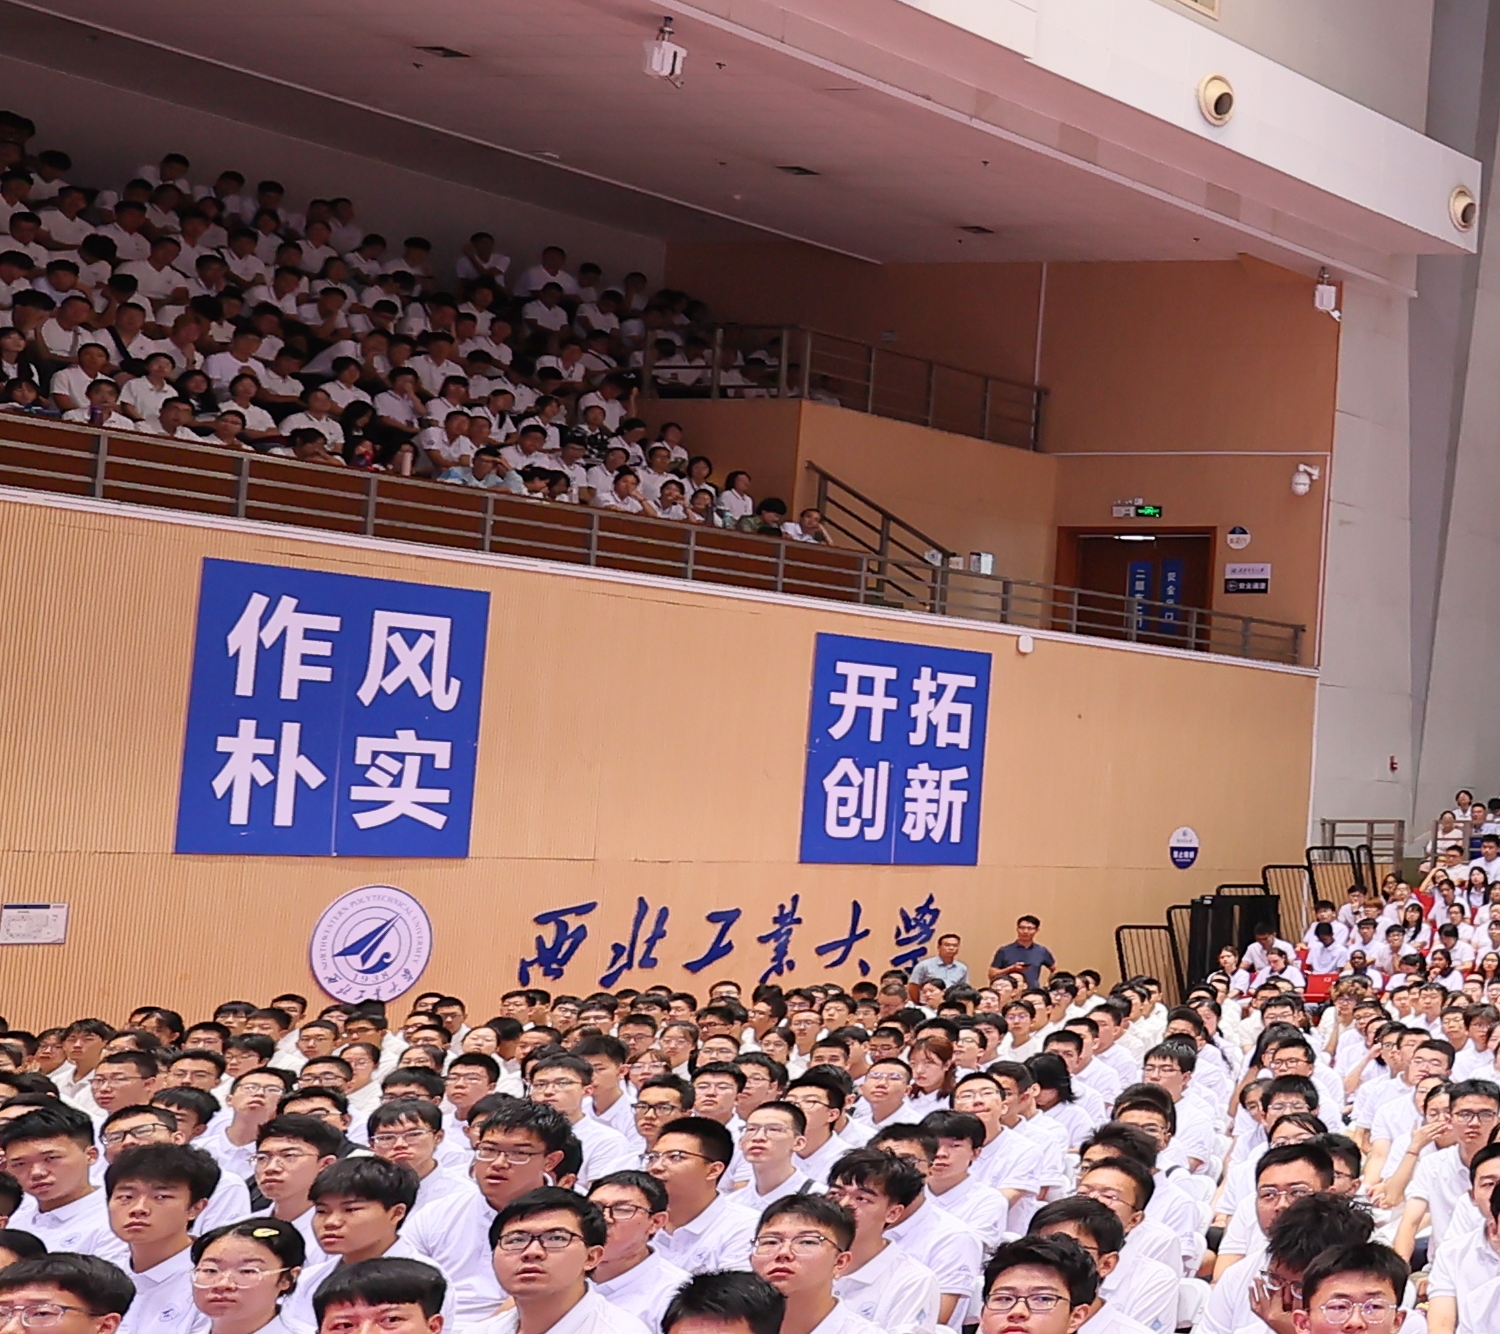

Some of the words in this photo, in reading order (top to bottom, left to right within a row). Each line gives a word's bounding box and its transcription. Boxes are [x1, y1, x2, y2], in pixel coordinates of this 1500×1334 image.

[227, 592, 462, 711] 作风
[827, 661, 977, 750] 开拓
[211, 719, 452, 830] 朴实
[822, 757, 969, 844] 创新
[352, 971, 390, 983] 1938
